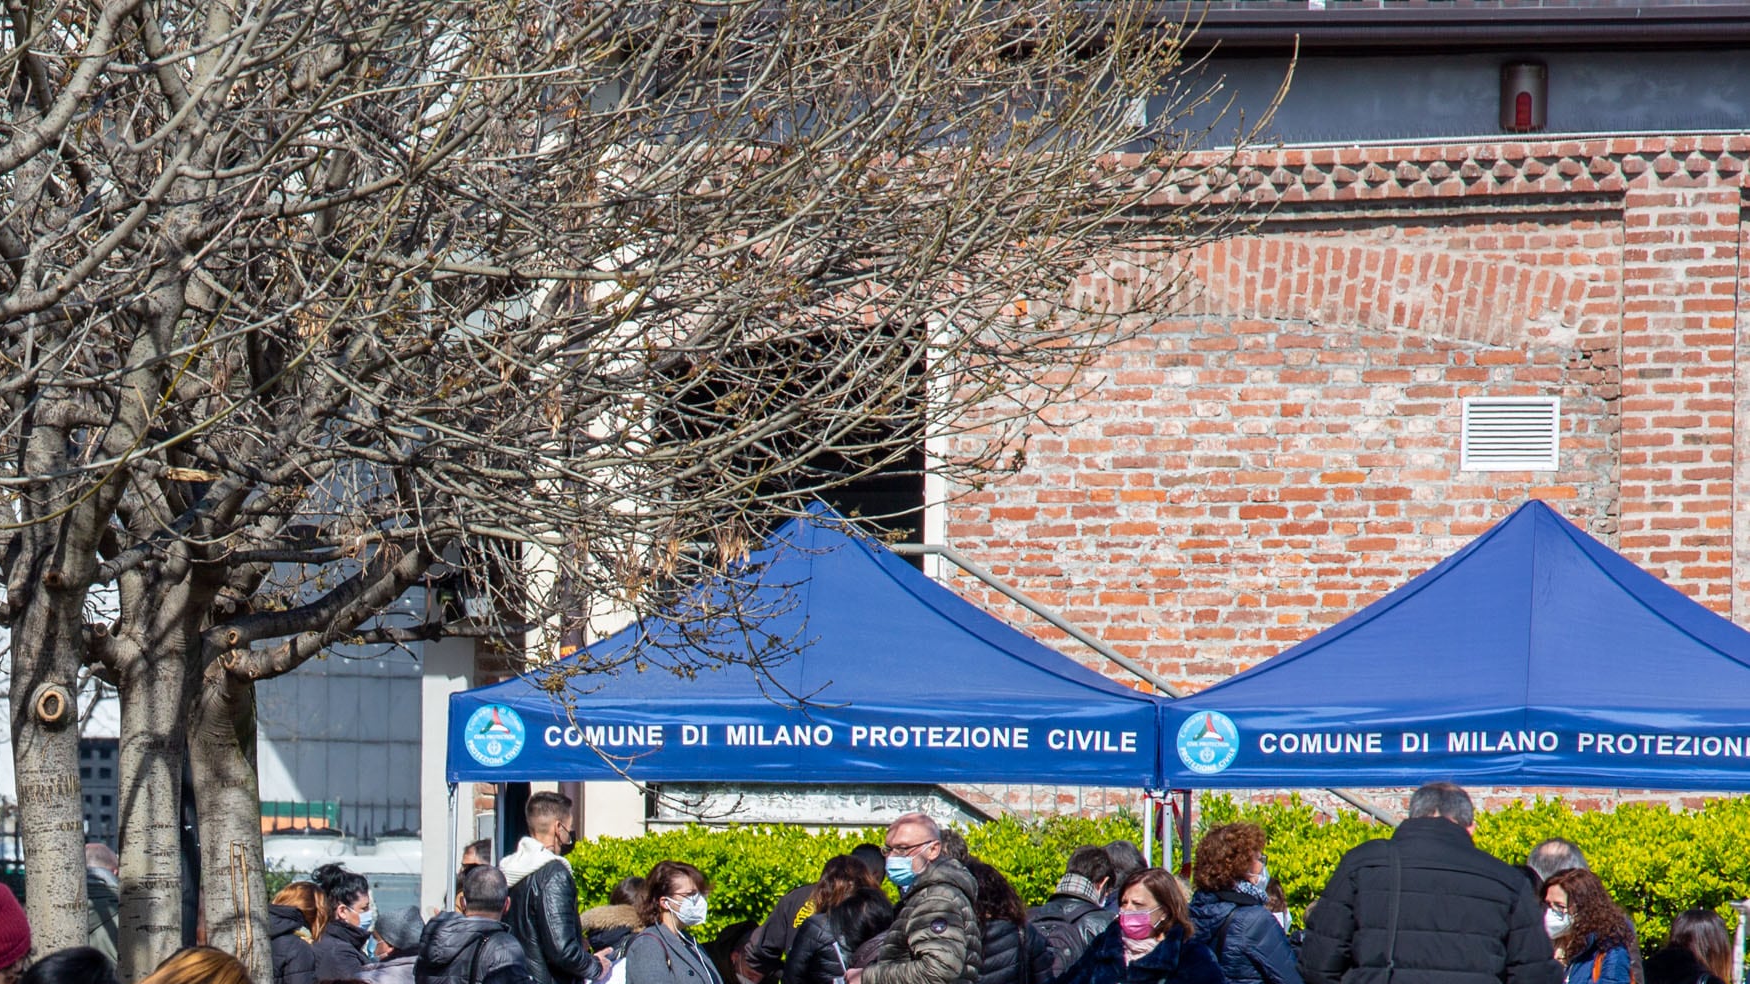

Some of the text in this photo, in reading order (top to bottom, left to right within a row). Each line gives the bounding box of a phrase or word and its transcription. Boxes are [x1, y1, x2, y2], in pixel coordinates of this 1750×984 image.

[544, 725, 1137, 753] COMUNE DI MILANO PROTEZIONE CIVILE
[1259, 731, 1750, 757] COMUNE DI MILANO PROTEZION
